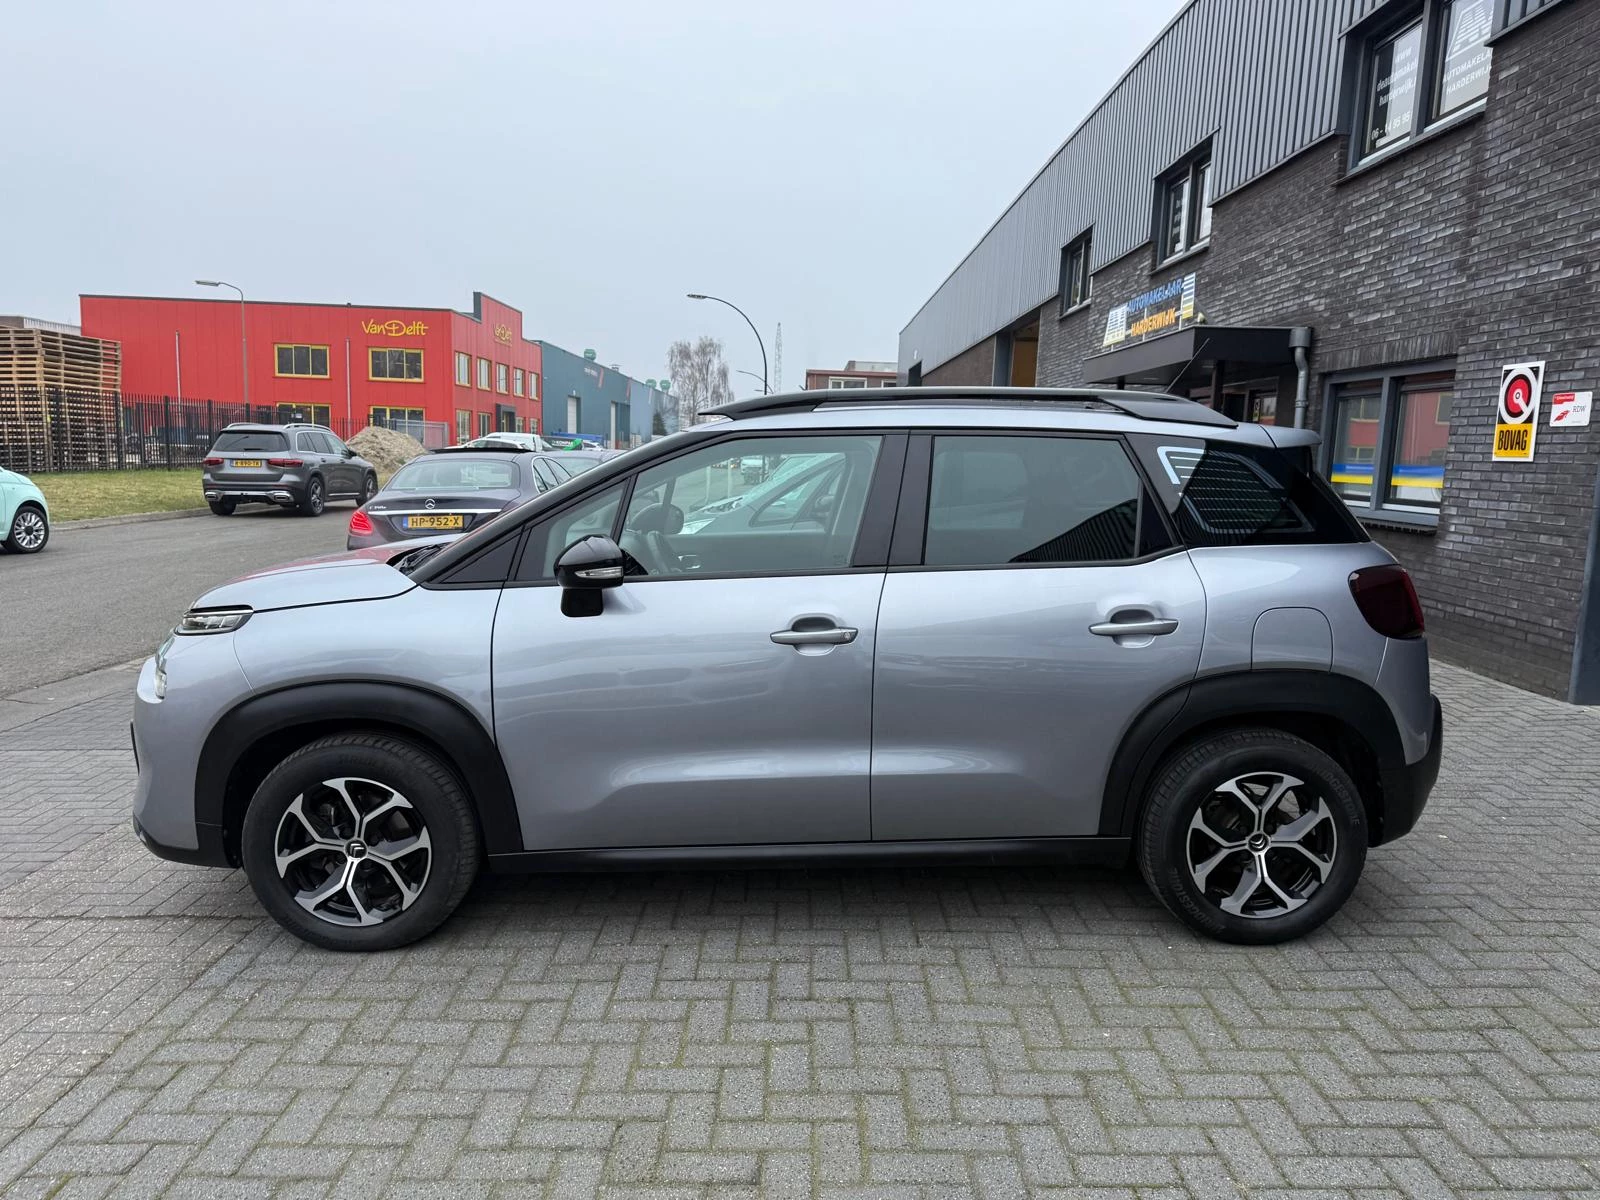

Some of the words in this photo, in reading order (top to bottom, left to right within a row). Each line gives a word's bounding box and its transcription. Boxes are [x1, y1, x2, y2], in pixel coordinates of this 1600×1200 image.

[1446, 64, 1491, 95] HARDERWIJ
[1128, 279, 1182, 314] AUTOMAKELAAR
[1131, 307, 1176, 336] HARDERWIJK
[1498, 429, 1527, 451] BOVAG
[411, 517, 460, 526] HP-952-X
